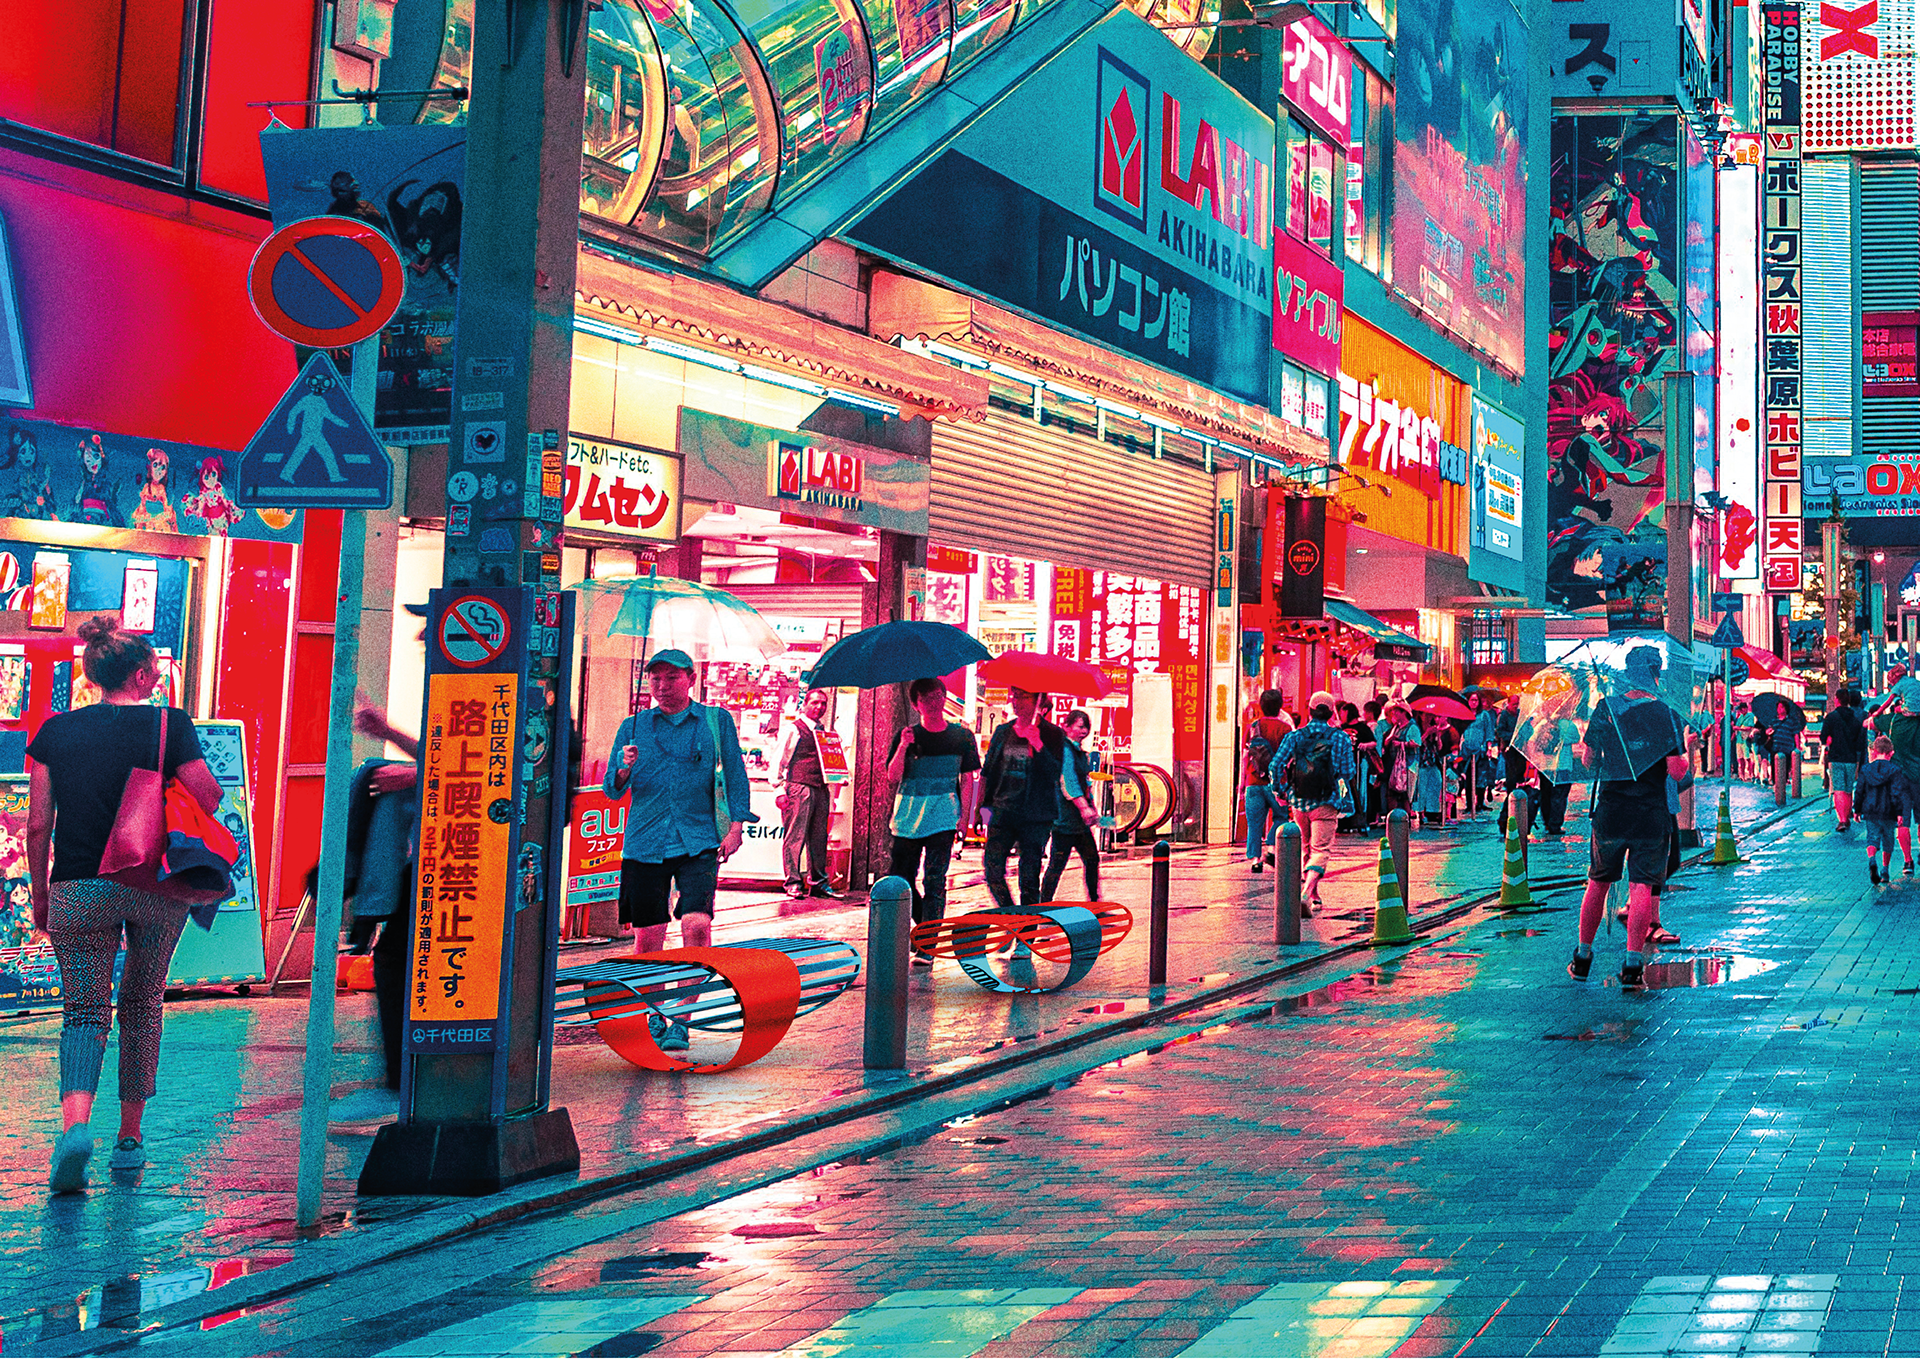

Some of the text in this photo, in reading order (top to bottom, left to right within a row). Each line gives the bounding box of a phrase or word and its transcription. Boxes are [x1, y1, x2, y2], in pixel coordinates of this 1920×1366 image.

[1289, 20, 1347, 126] アコム
[1767, 10, 1782, 120] PARADISE
[1782, 10, 1798, 85] HOBBY
[1161, 91, 1269, 250] LABI
[1157, 209, 1267, 300] AKIHABARA
[1060, 234, 1191, 358] パソコン館
[1293, 274, 1341, 345] アイフル
[1863, 328, 1890, 343] 本店
[567, 442, 653, 475] フト&ハードetc.
[807, 448, 862, 493] LABI
[806, 489, 864, 512] AKIHABARA
[488, 684, 511, 787] 千代田区内は
[436, 699, 487, 1009] 路上喫煙禁止です。
[580, 807, 626, 838] au
[587, 837, 617, 853] フェア
[426, 1027, 493, 1044] 千代田区
